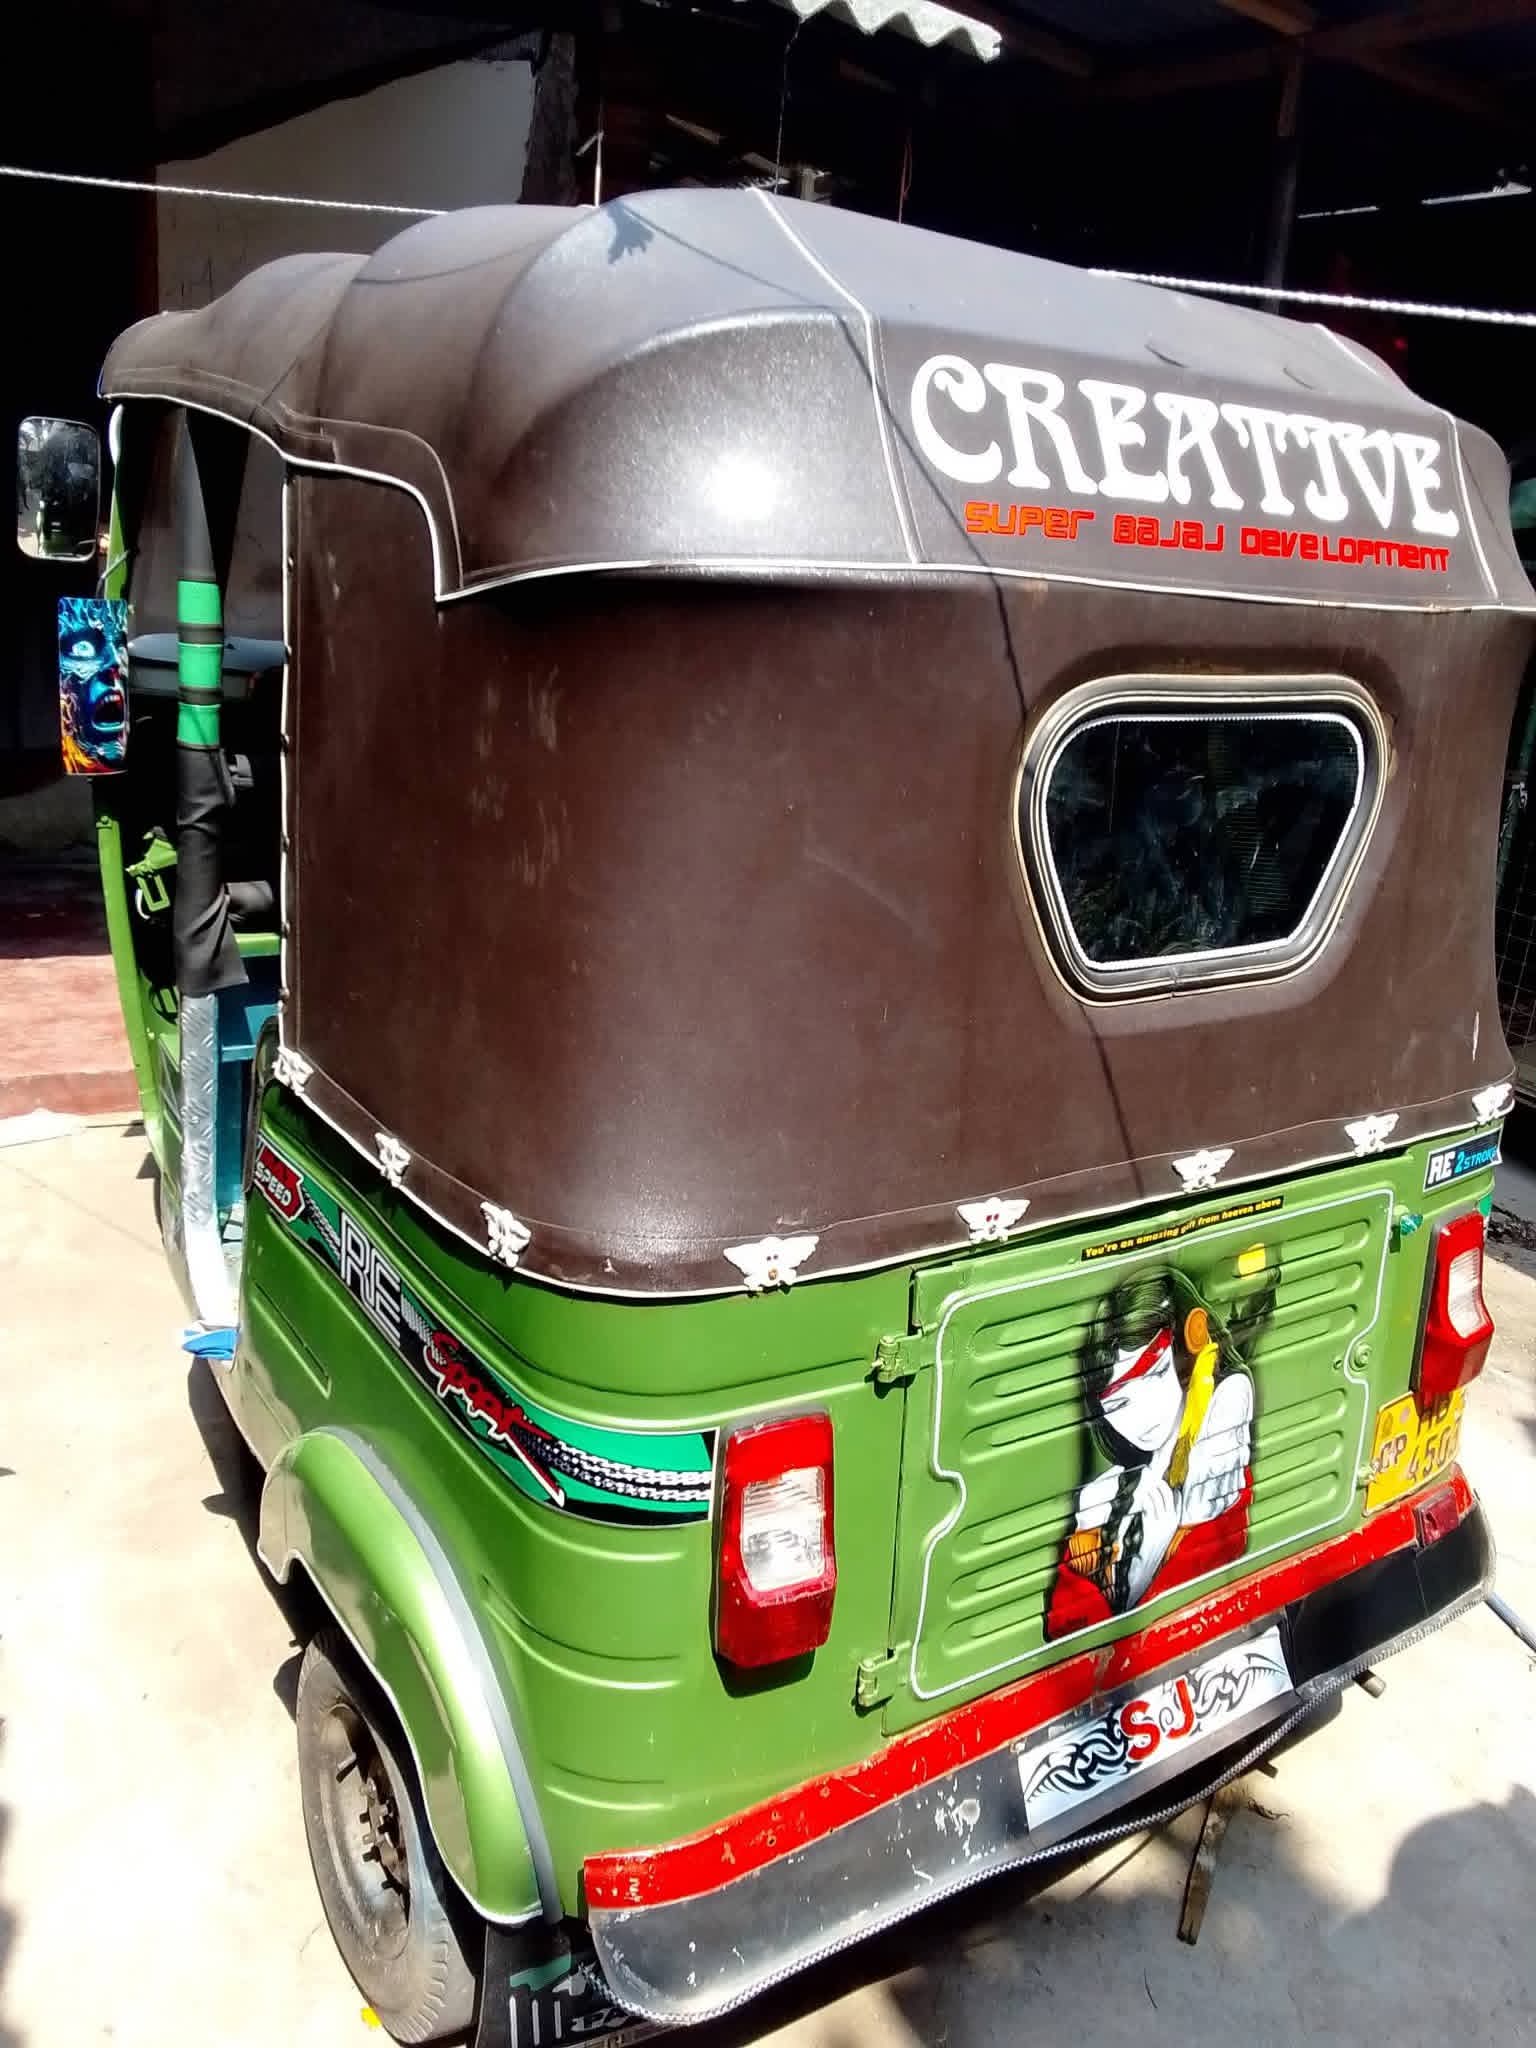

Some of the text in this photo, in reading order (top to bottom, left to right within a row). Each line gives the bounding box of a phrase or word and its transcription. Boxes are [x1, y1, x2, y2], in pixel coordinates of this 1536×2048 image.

[911, 354, 1459, 537] CREATIVE
[255, 1161, 292, 1206] SPEED
[1427, 1151, 1456, 1184] RE
[1086, 1243, 1118, 1258] You're
[1120, 1239, 1134, 1249] an
[1136, 1229, 1179, 1245] amazing
[1198, 1214, 1220, 1226] from
[1222, 1205, 1254, 1220] heaven
[1255, 1198, 1281, 1211] above
[340, 1211, 401, 1348] RE
[1380, 1434, 1408, 1474] CP
